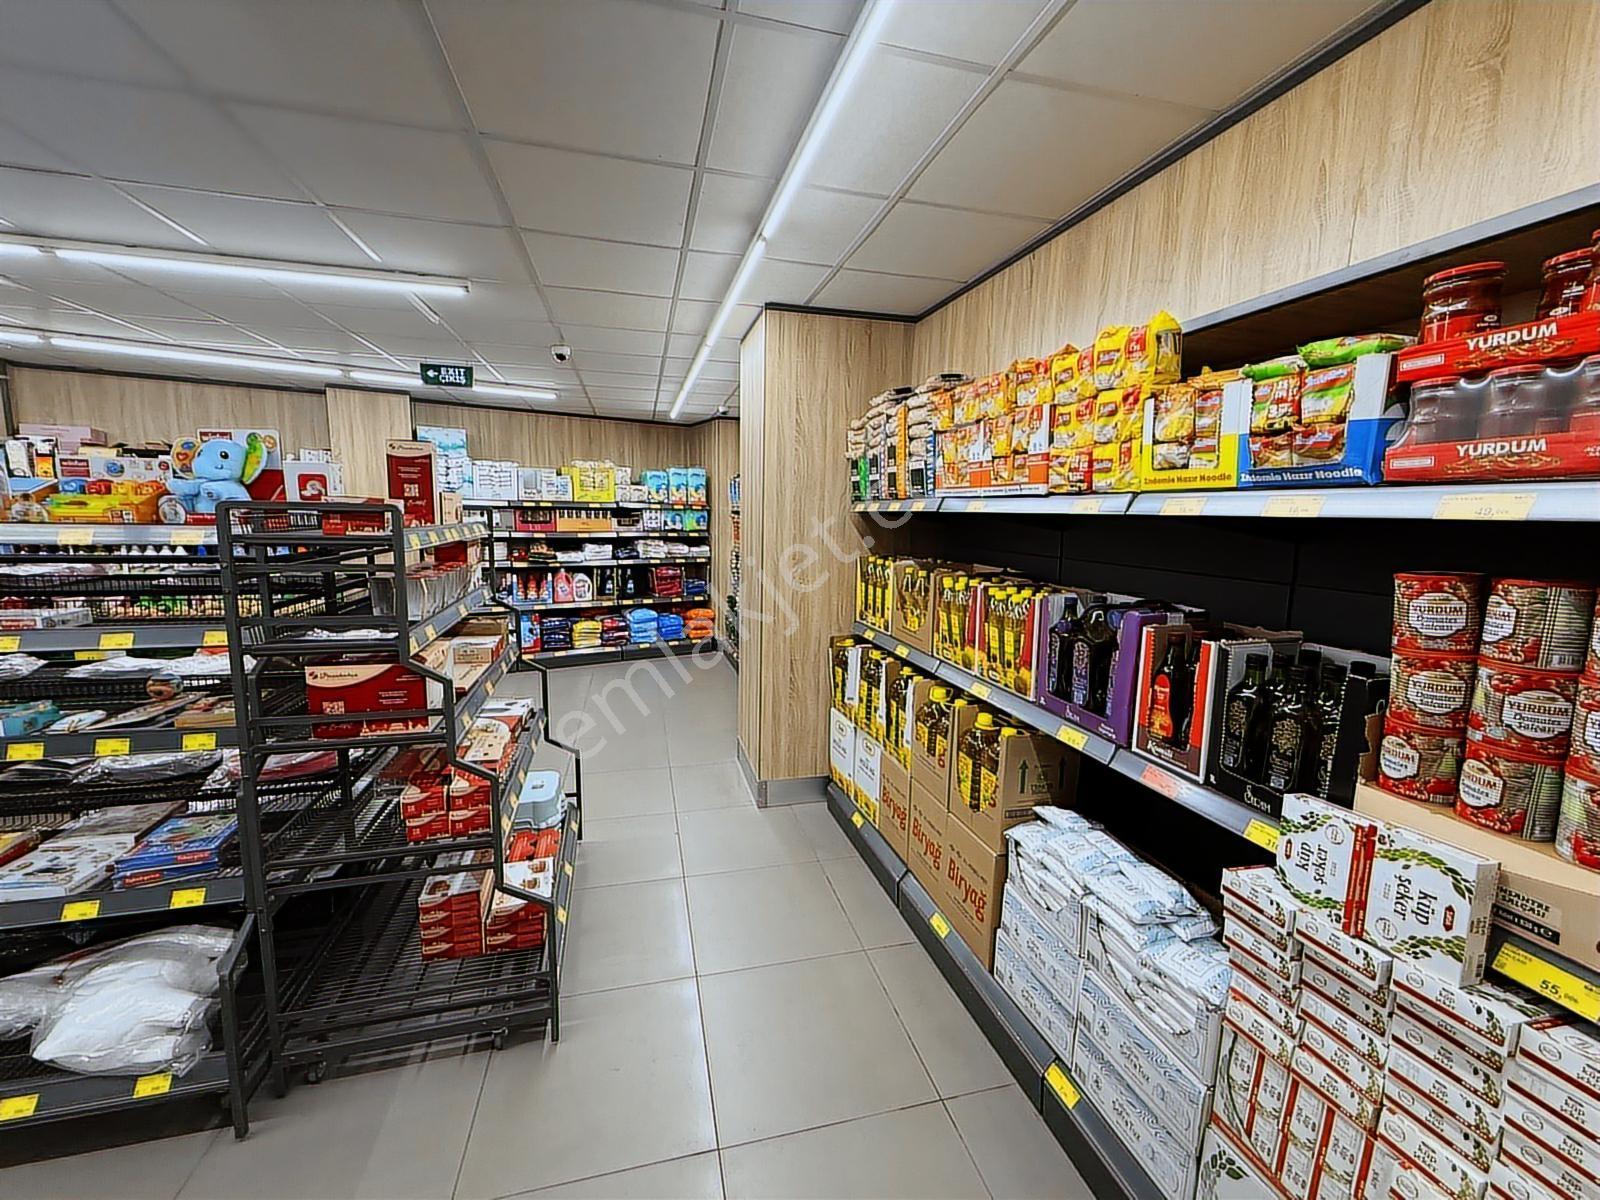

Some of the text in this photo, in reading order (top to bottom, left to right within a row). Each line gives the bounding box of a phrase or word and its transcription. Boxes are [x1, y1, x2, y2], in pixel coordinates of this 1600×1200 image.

[1466, 322, 1558, 351] YURDUM
[440, 366, 466, 375] EXIT
[1456, 438, 1547, 457] YURDUM
[1199, 473, 1232, 483] Noodle
[1240, 473, 1282, 483] Indomie
[1315, 467, 1364, 480] Noodle
[1412, 605, 1464, 615] YURDUM
[1409, 680, 1463, 694] YURDUM
[1508, 701, 1569, 716] YURDUM
[1513, 713, 1561, 726] Domates
[883, 784, 908, 831] Biryağ
[911, 816, 942, 871] Biryağ
[1295, 841, 1315, 872] küp
[1312, 844, 1329, 886] şeker
[947, 855, 988, 923] Biryağ
[1393, 873, 1415, 922] şeker
[1410, 888, 1438, 926] küp
